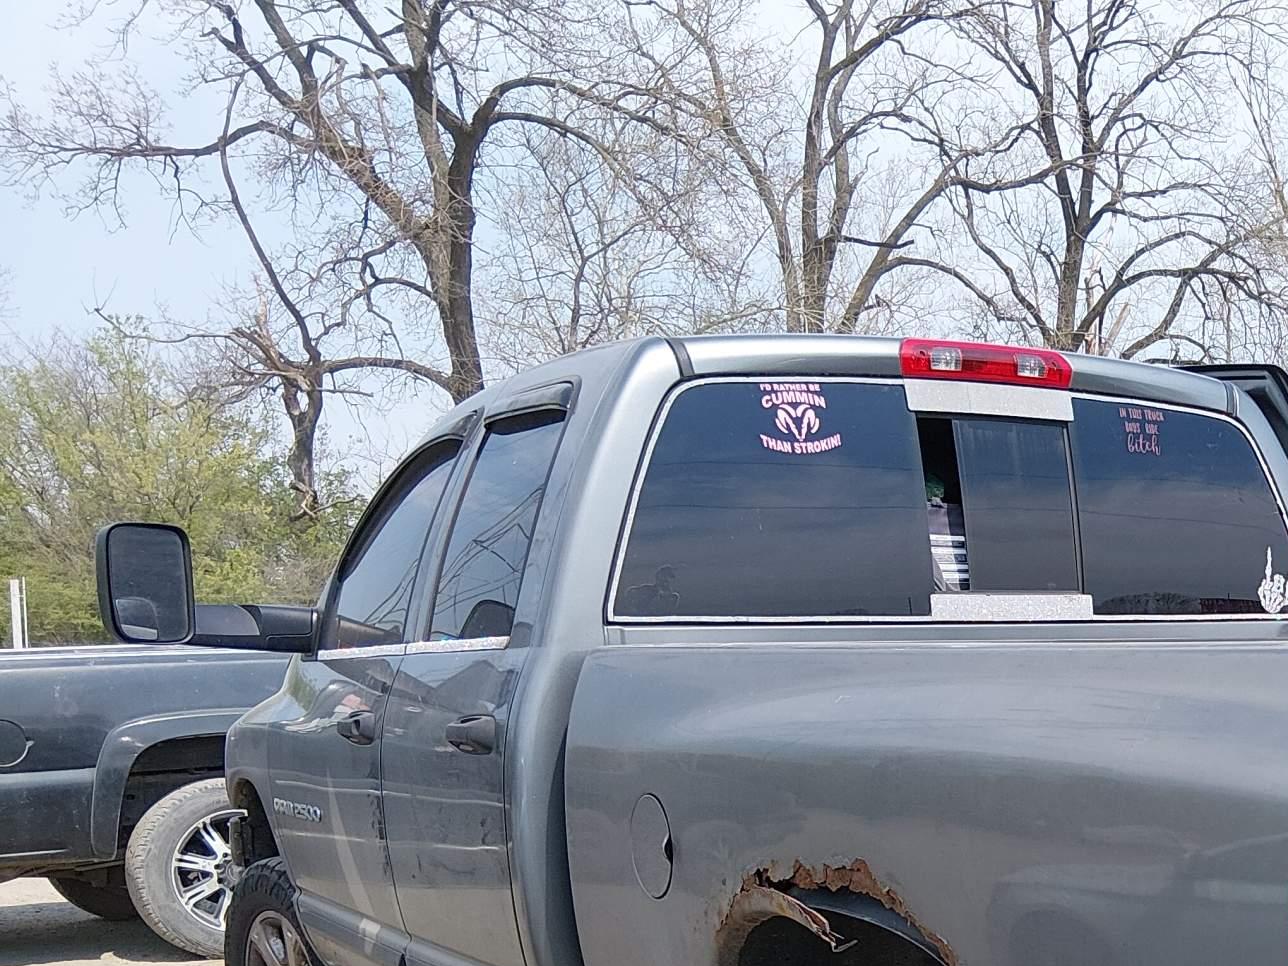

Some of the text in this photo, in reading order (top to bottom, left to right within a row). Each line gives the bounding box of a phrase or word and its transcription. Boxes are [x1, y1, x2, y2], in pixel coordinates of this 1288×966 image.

[773, 383, 808, 391] RATHER
[808, 383, 821, 391] BE
[761, 391, 826, 409] CUMMIN
[760, 433, 842, 454] THAN STROKIN!
[1127, 433, 1161, 456] bitch
[294, 802, 321, 823] 2500
